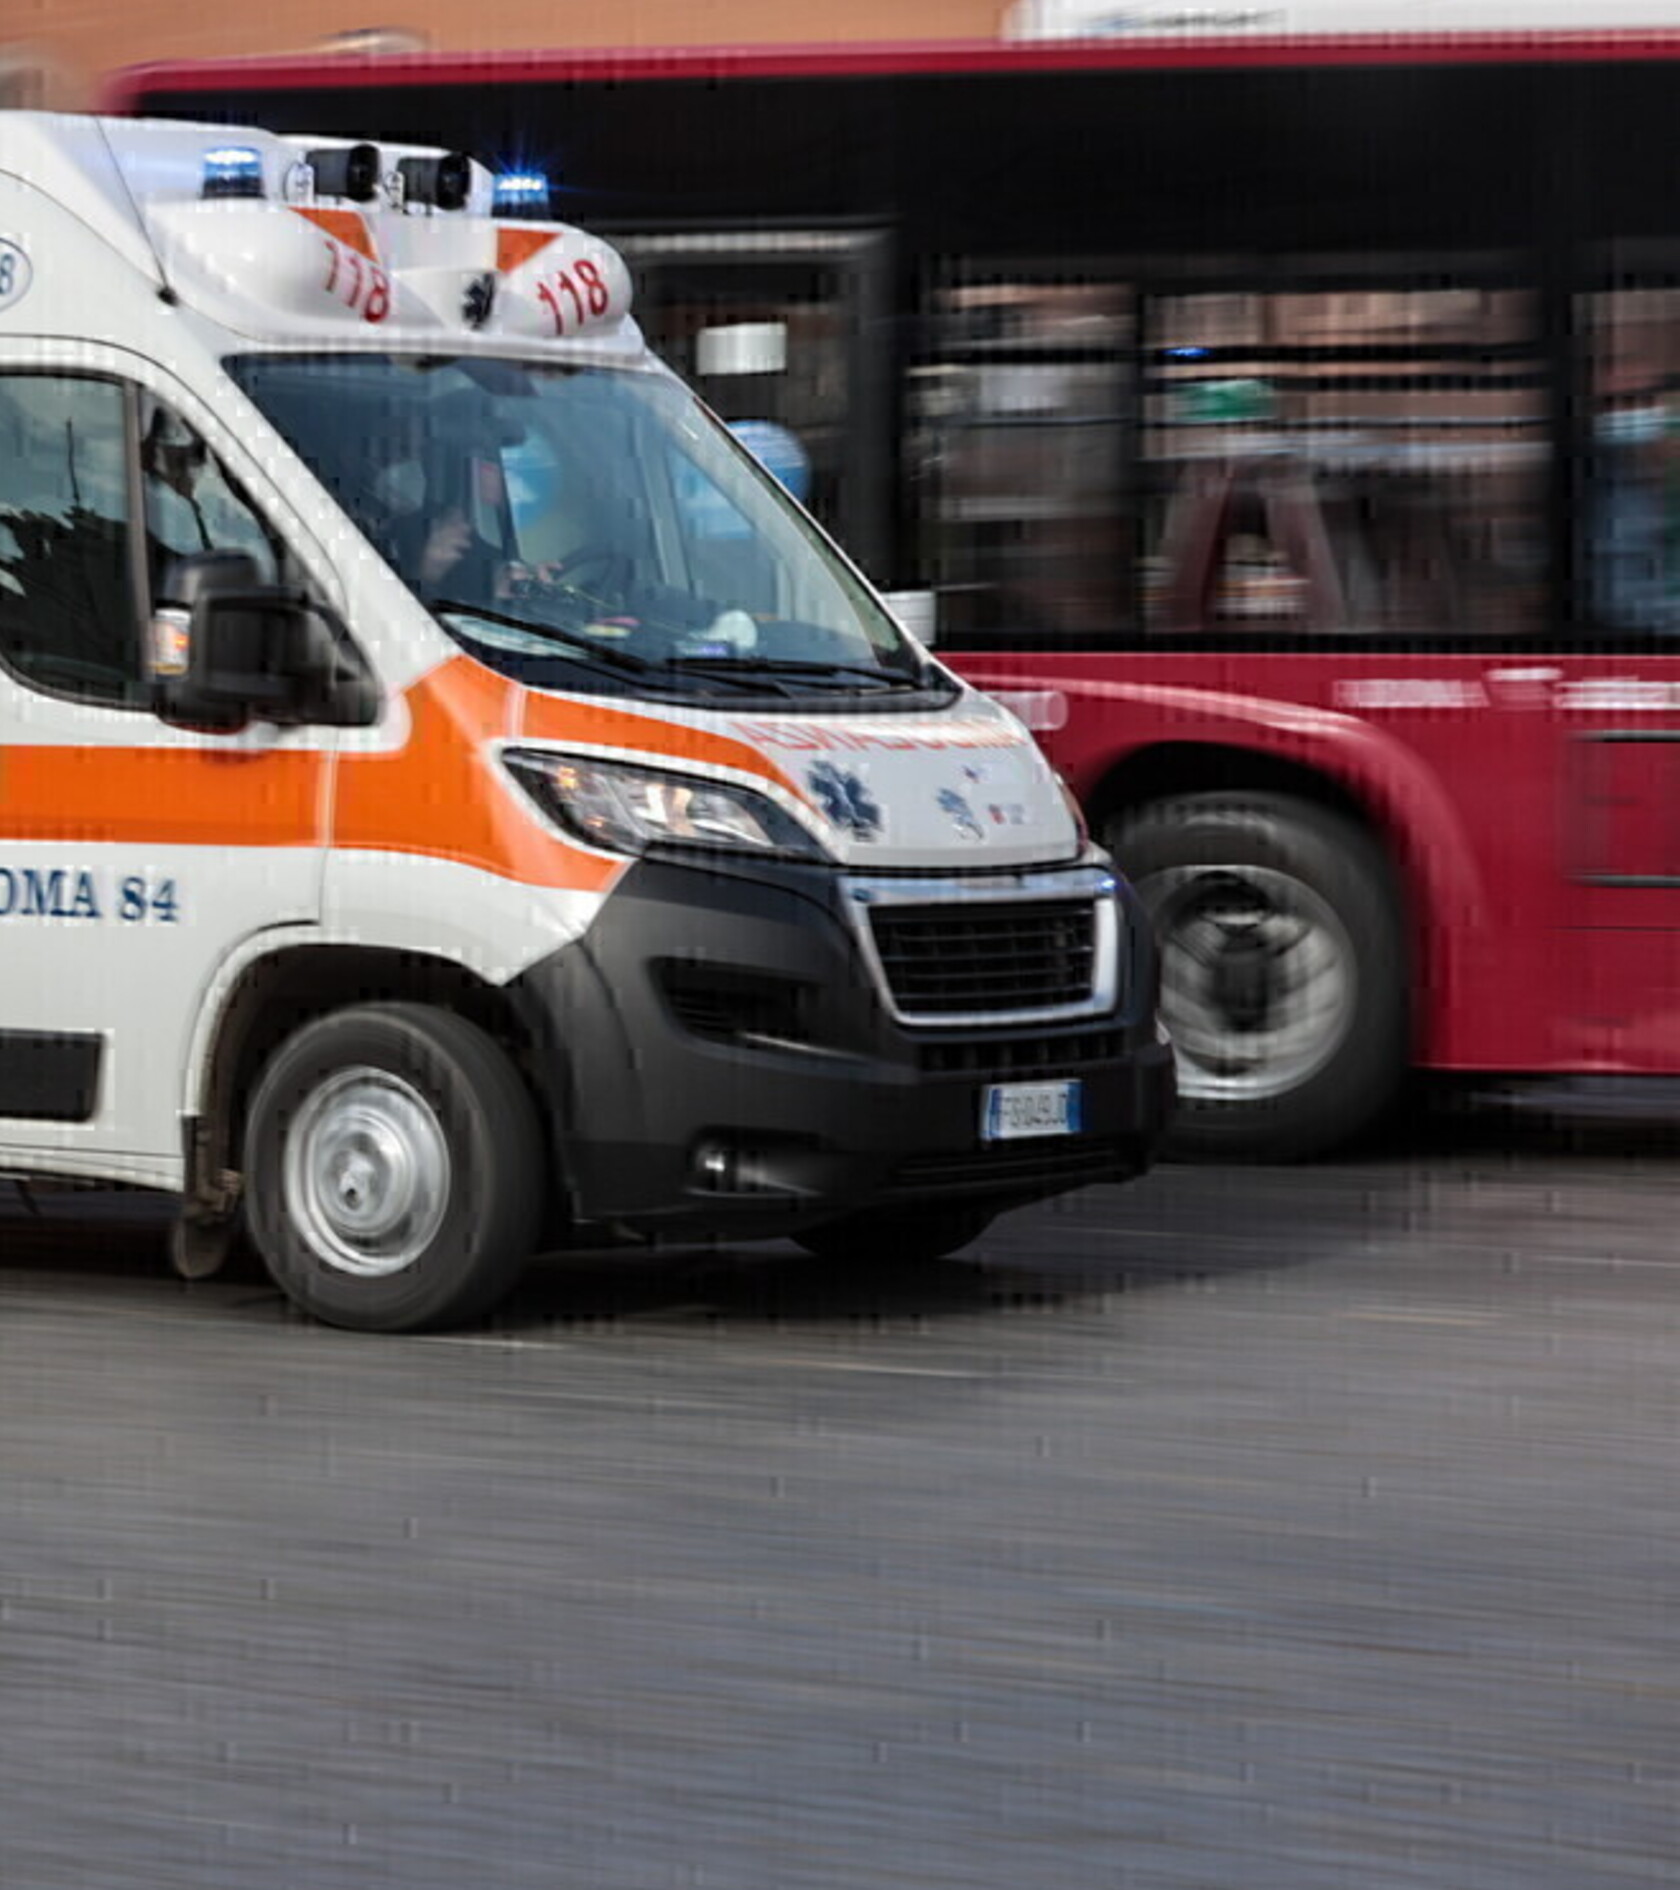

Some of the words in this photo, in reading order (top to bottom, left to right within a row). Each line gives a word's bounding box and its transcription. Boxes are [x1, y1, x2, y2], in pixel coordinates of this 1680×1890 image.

[324, 240, 390, 323] 118
[537, 259, 609, 336] 118
[120, 876, 179, 922] 84
